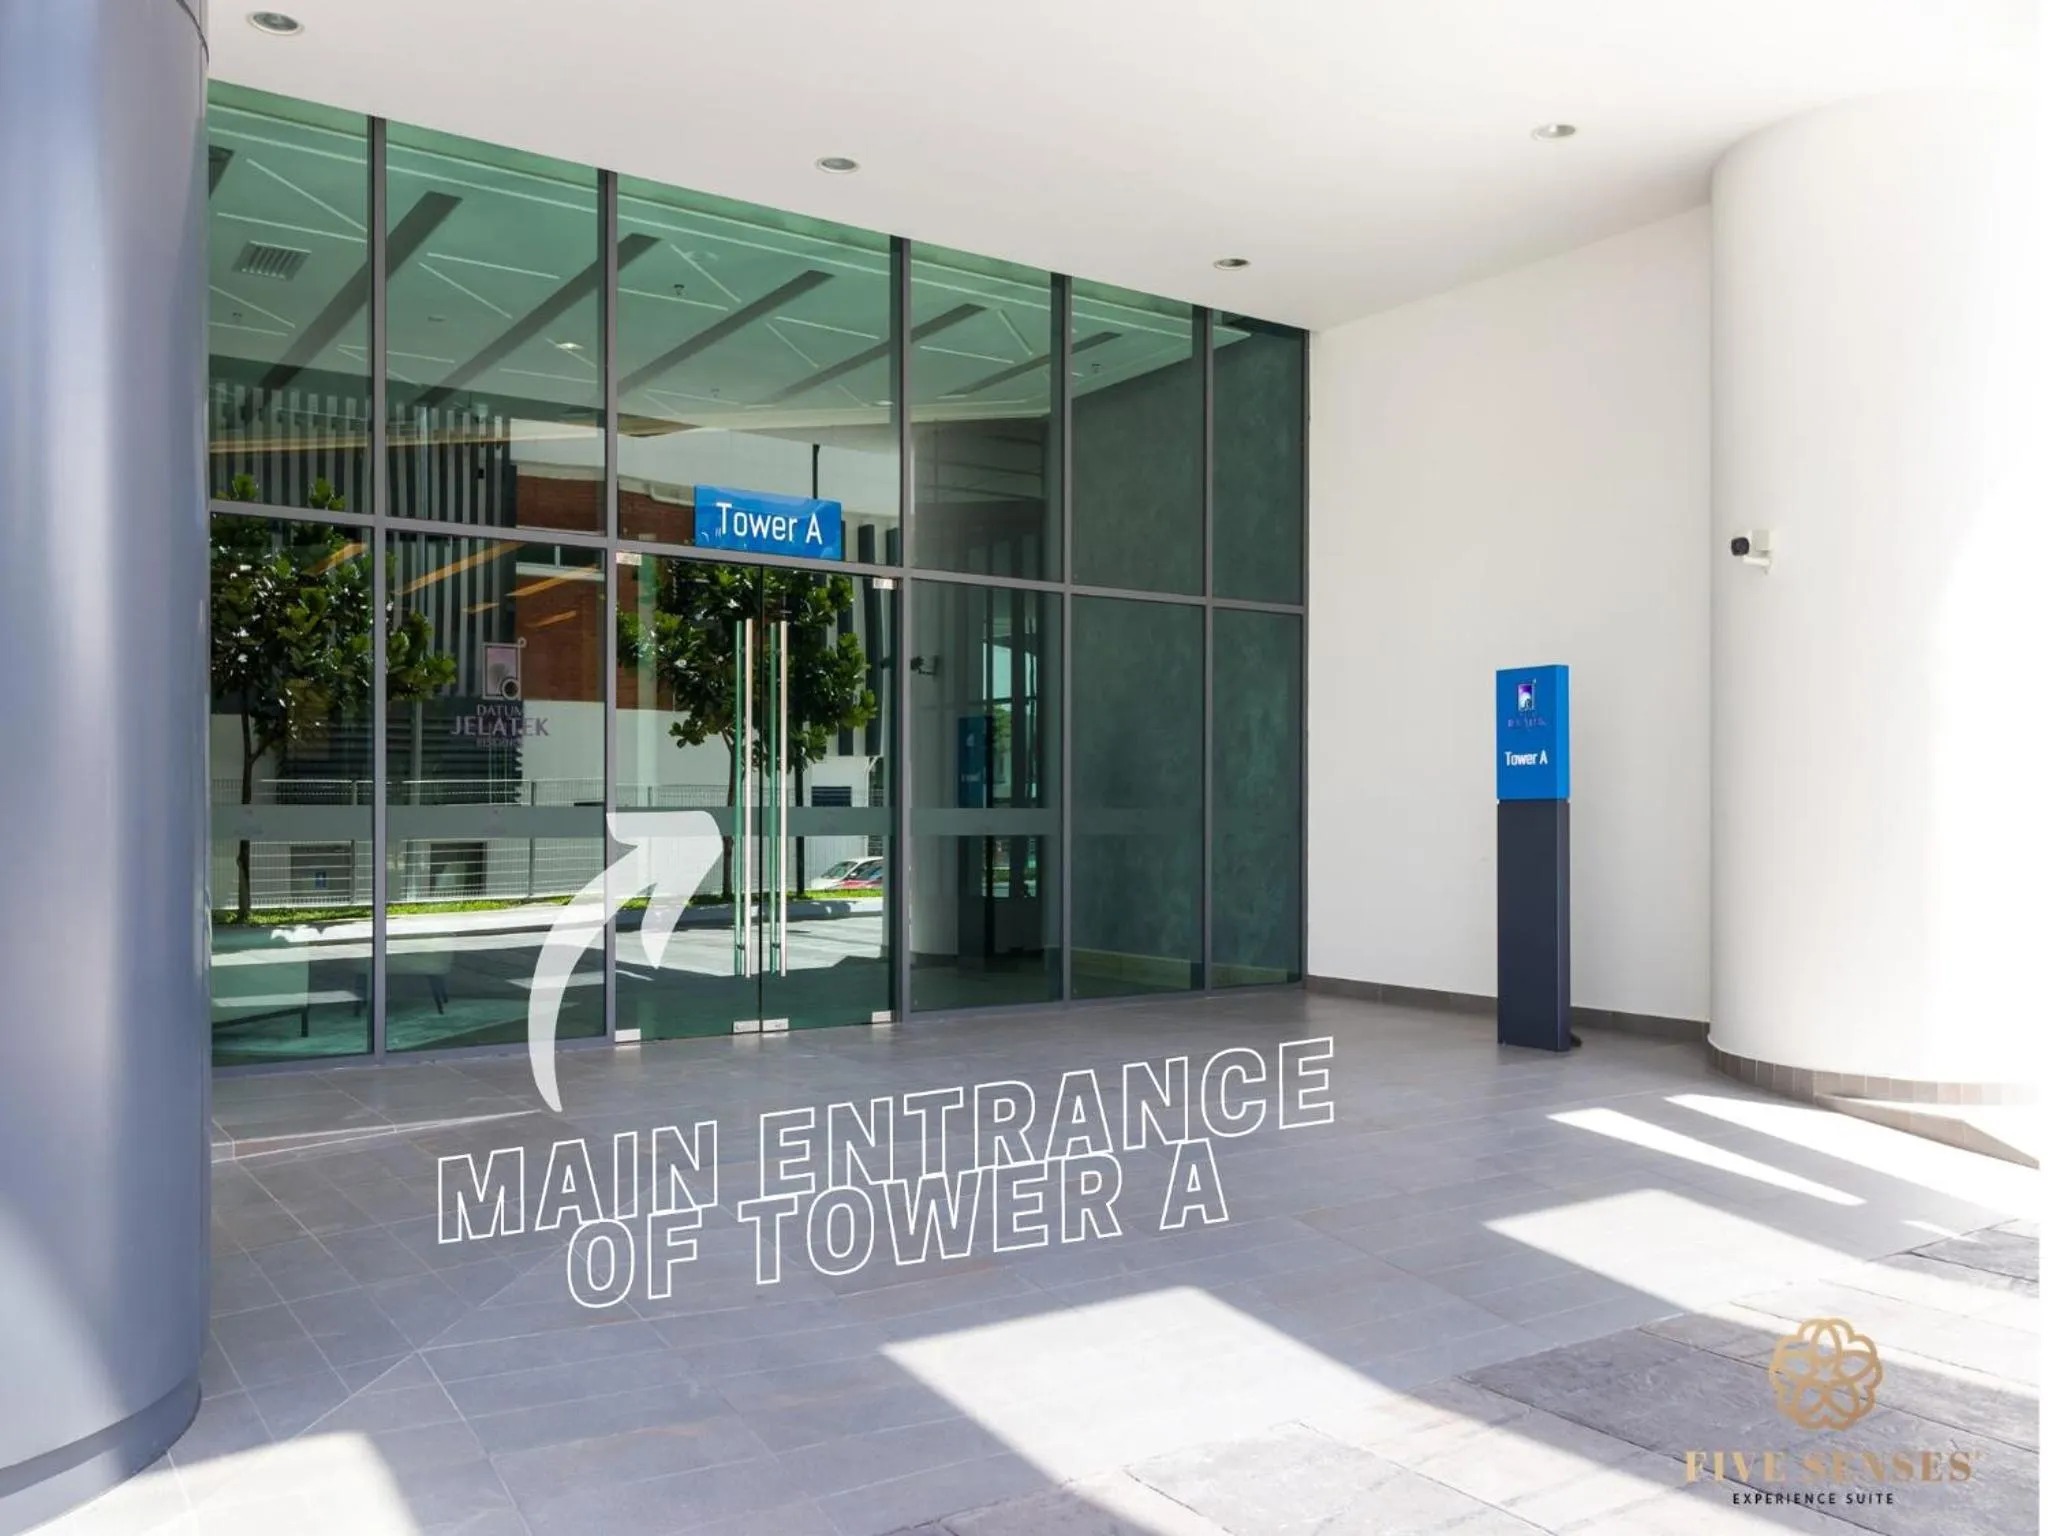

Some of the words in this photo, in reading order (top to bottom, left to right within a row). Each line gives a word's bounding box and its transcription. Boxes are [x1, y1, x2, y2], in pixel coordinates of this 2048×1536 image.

[716, 502, 797, 541] Tower
[805, 513, 823, 545] A
[450, 716, 549, 737] JELATEK
[1504, 751, 1538, 767] Tower
[1539, 750, 1549, 766] A
